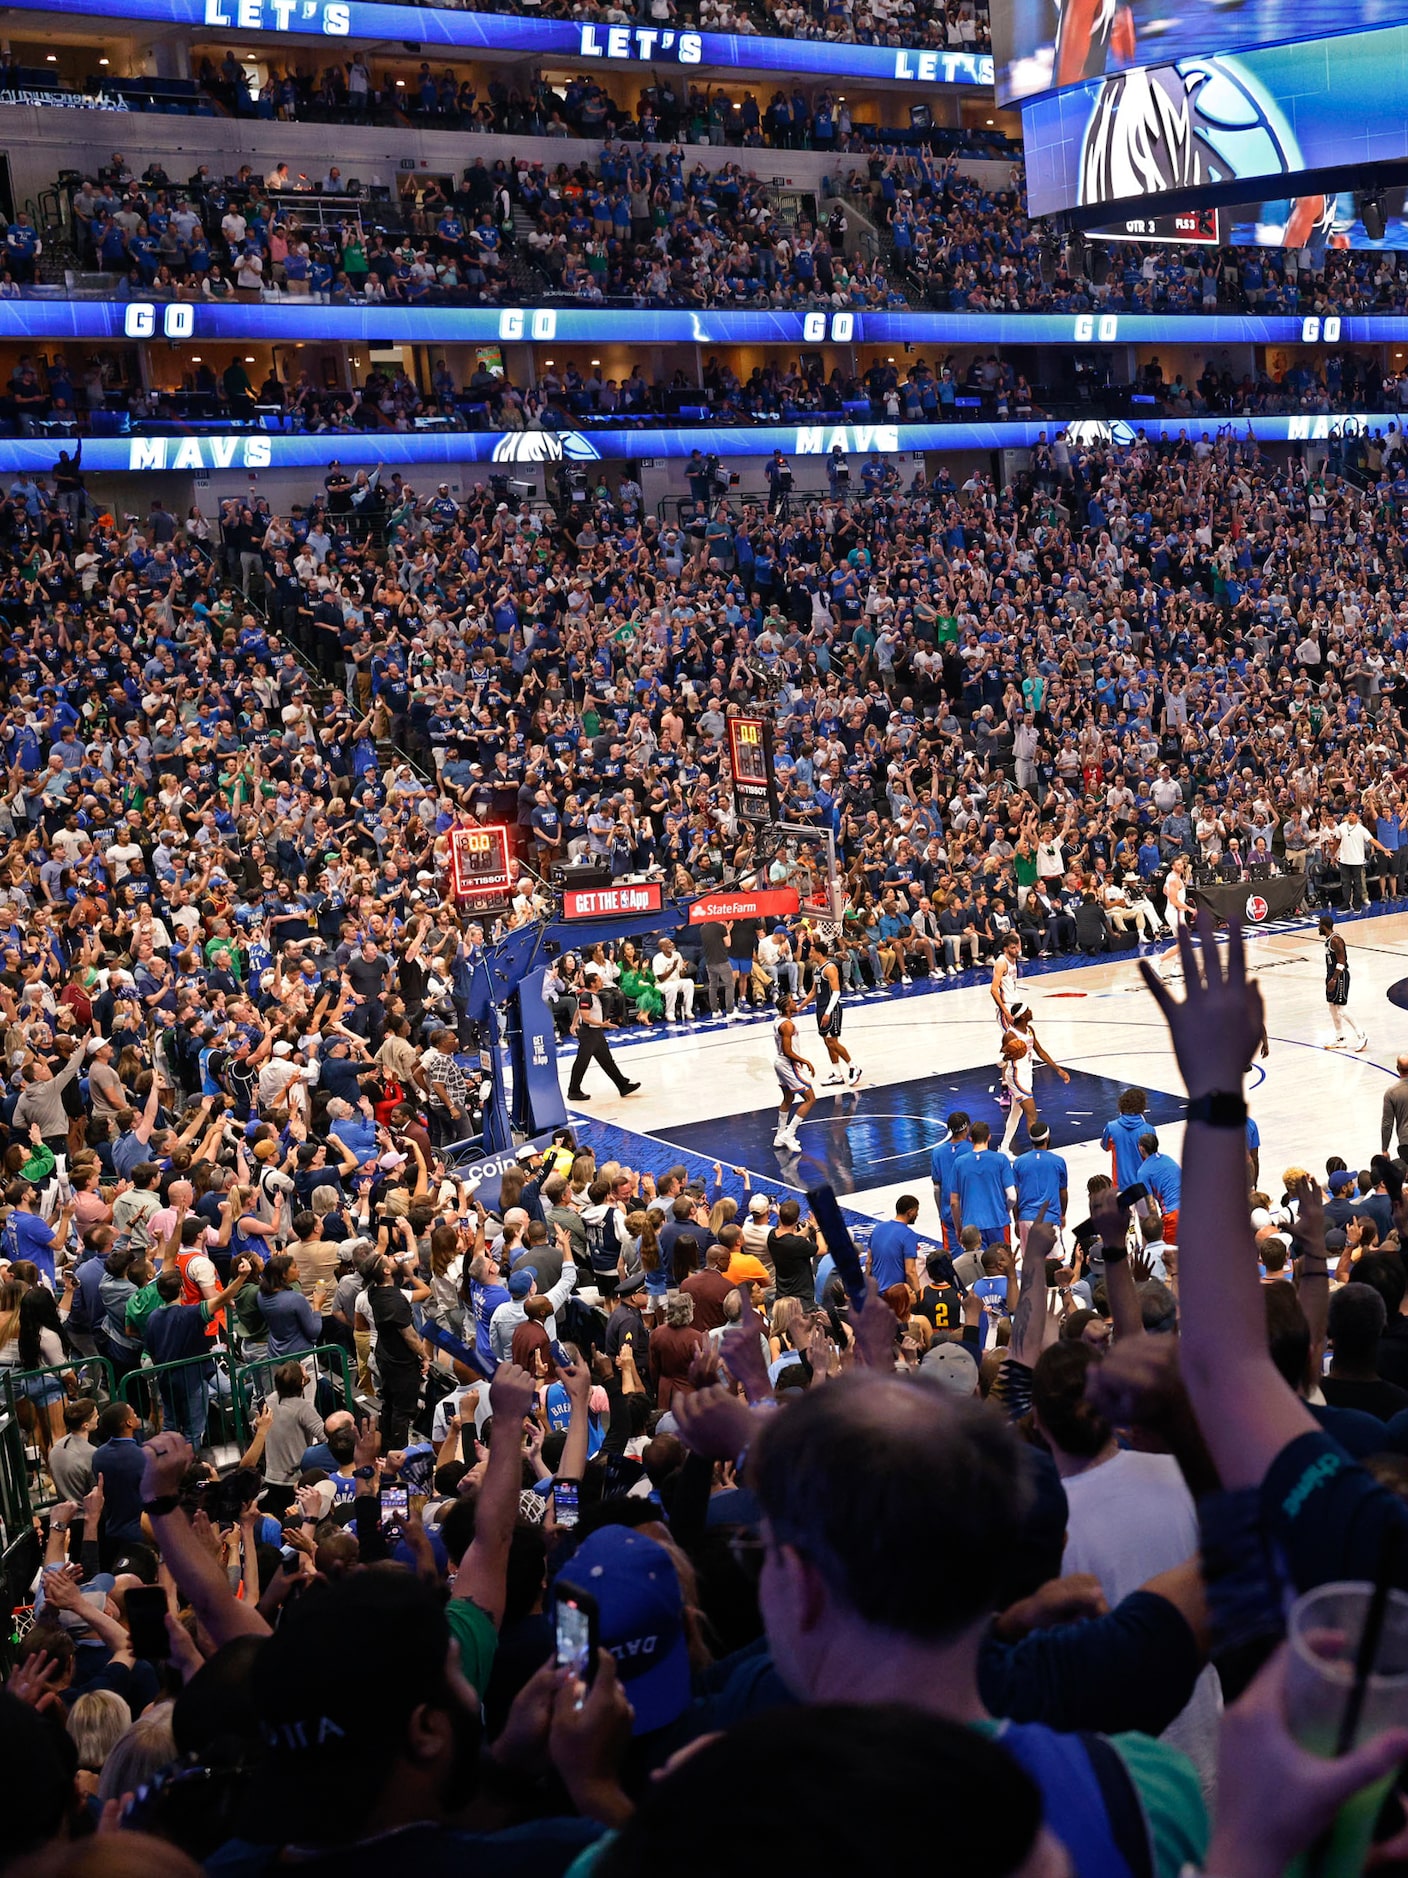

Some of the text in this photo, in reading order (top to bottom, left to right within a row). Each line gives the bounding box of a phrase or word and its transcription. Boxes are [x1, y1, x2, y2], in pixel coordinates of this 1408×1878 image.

[207, 0, 349, 34] LET'S
[582, 27, 701, 62] LET'S
[896, 52, 994, 83] LET'S
[1126, 220, 1156, 233] QTR 3
[1175, 219, 1195, 230] FLS 3
[125, 303, 194, 337] GO
[499, 308, 556, 339] GO
[804, 313, 852, 340] GO
[1075, 315, 1117, 340] GO
[1303, 318, 1340, 341] GO
[796, 426, 897, 453] MAVS
[130, 437, 270, 468] MAVS
[740, 725, 757, 744] 0.0
[745, 785, 767, 796] TISSOT
[469, 835, 489, 850] 0.0
[474, 874, 507, 885] TISSOT
[576, 890, 649, 912] GET THE App
[532, 1035, 543, 1045] GET
[535, 1045, 545, 1054] THE
[936, 1303, 949, 1327] 2
